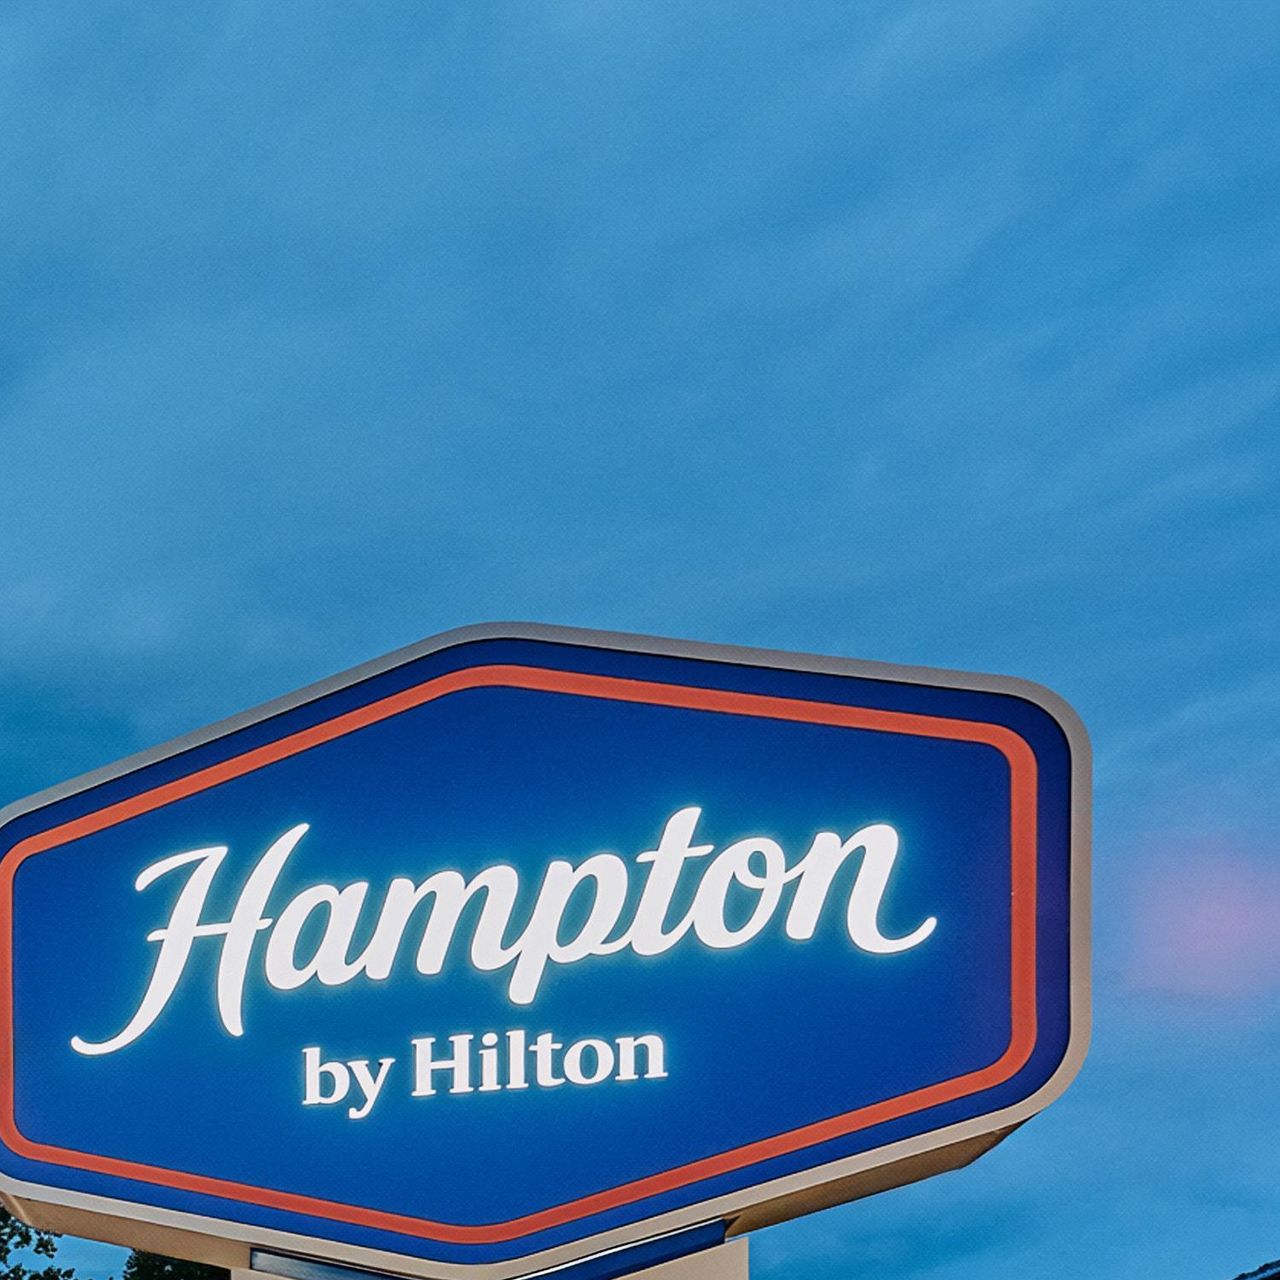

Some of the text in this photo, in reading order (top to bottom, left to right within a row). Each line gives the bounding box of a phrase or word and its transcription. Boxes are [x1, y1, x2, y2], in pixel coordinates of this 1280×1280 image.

[70, 805, 938, 1057] Hampton
[301, 1029, 669, 1119] by Hilton
